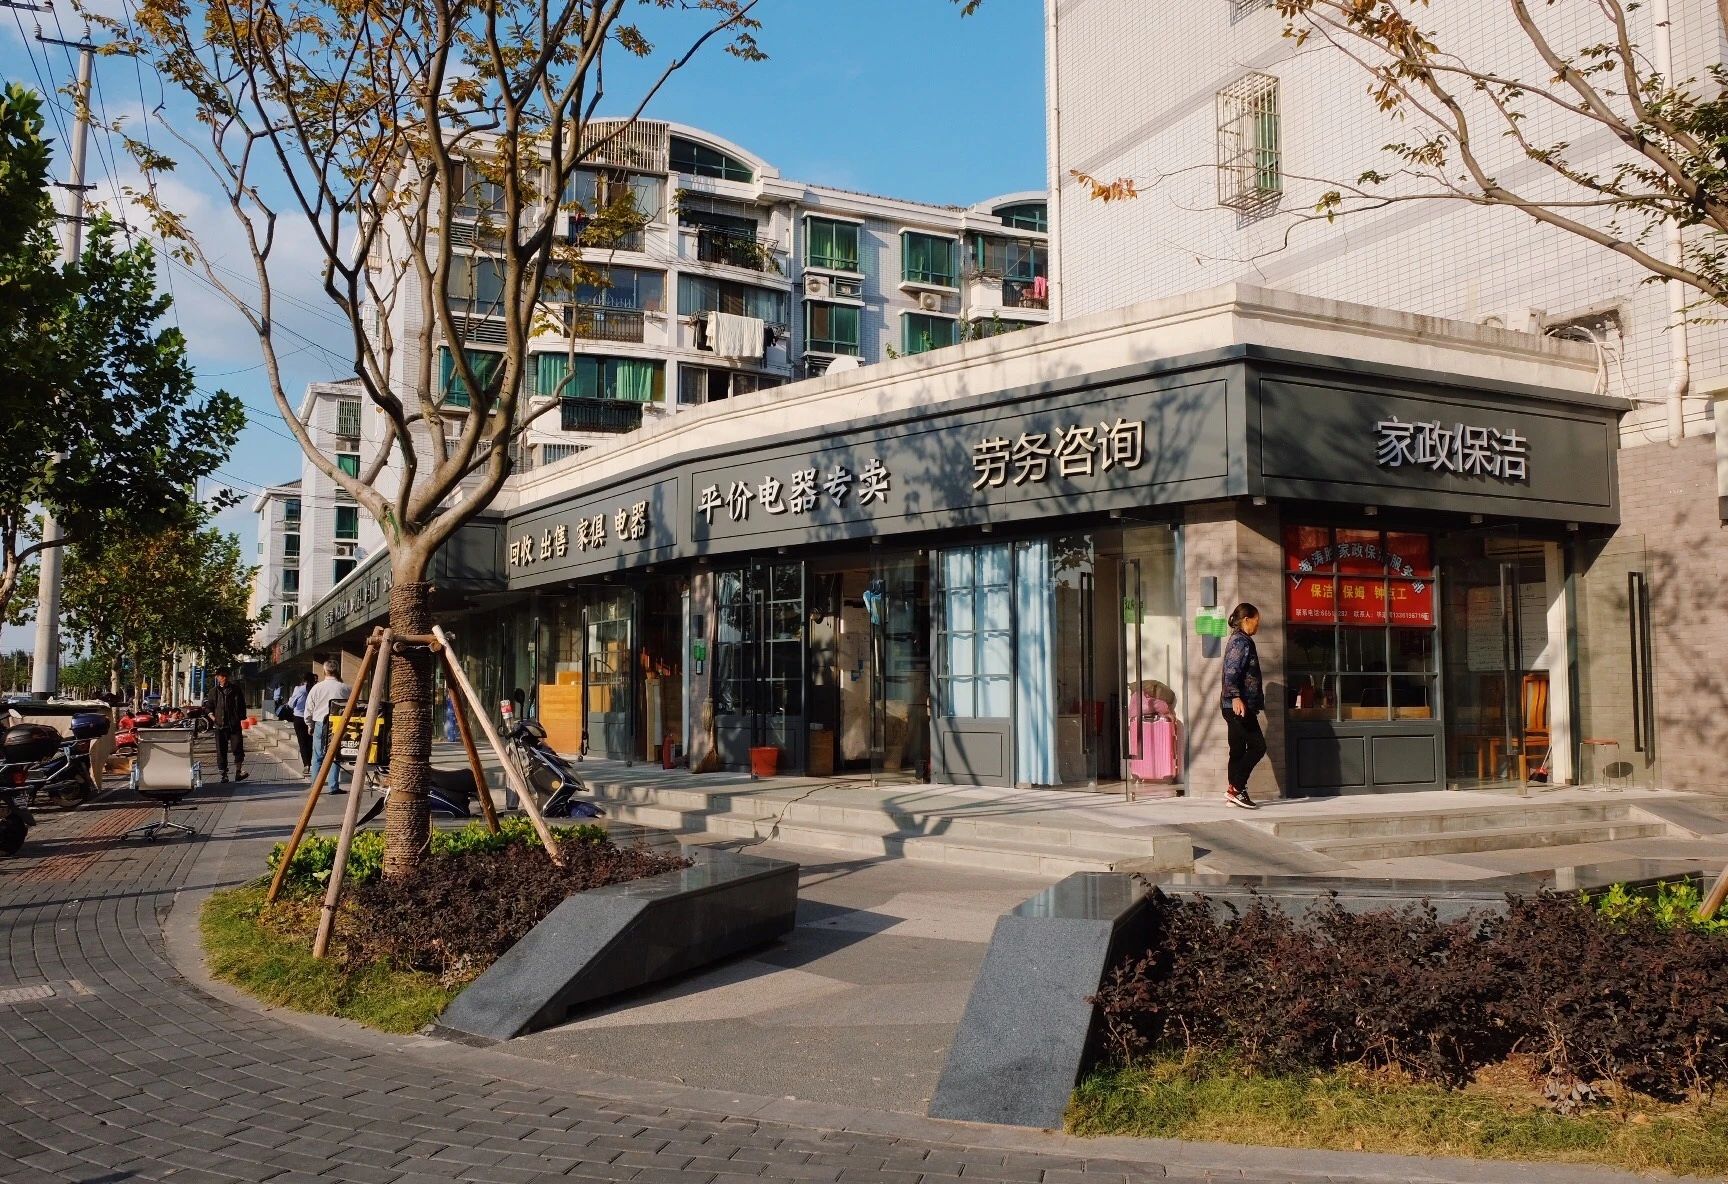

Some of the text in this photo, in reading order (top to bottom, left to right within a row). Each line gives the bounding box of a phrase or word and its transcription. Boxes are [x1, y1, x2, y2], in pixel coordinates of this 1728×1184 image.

[972, 417, 1144, 489] 劳务咨询
[1374, 415, 1527, 481] 家政保洁
[697, 458, 890, 524] 平价电器专卖
[509, 500, 649, 566] 回收 出售 家俱 电器
[1311, 583, 1334, 599] 保洁
[1343, 585, 1365, 600] 保姆
